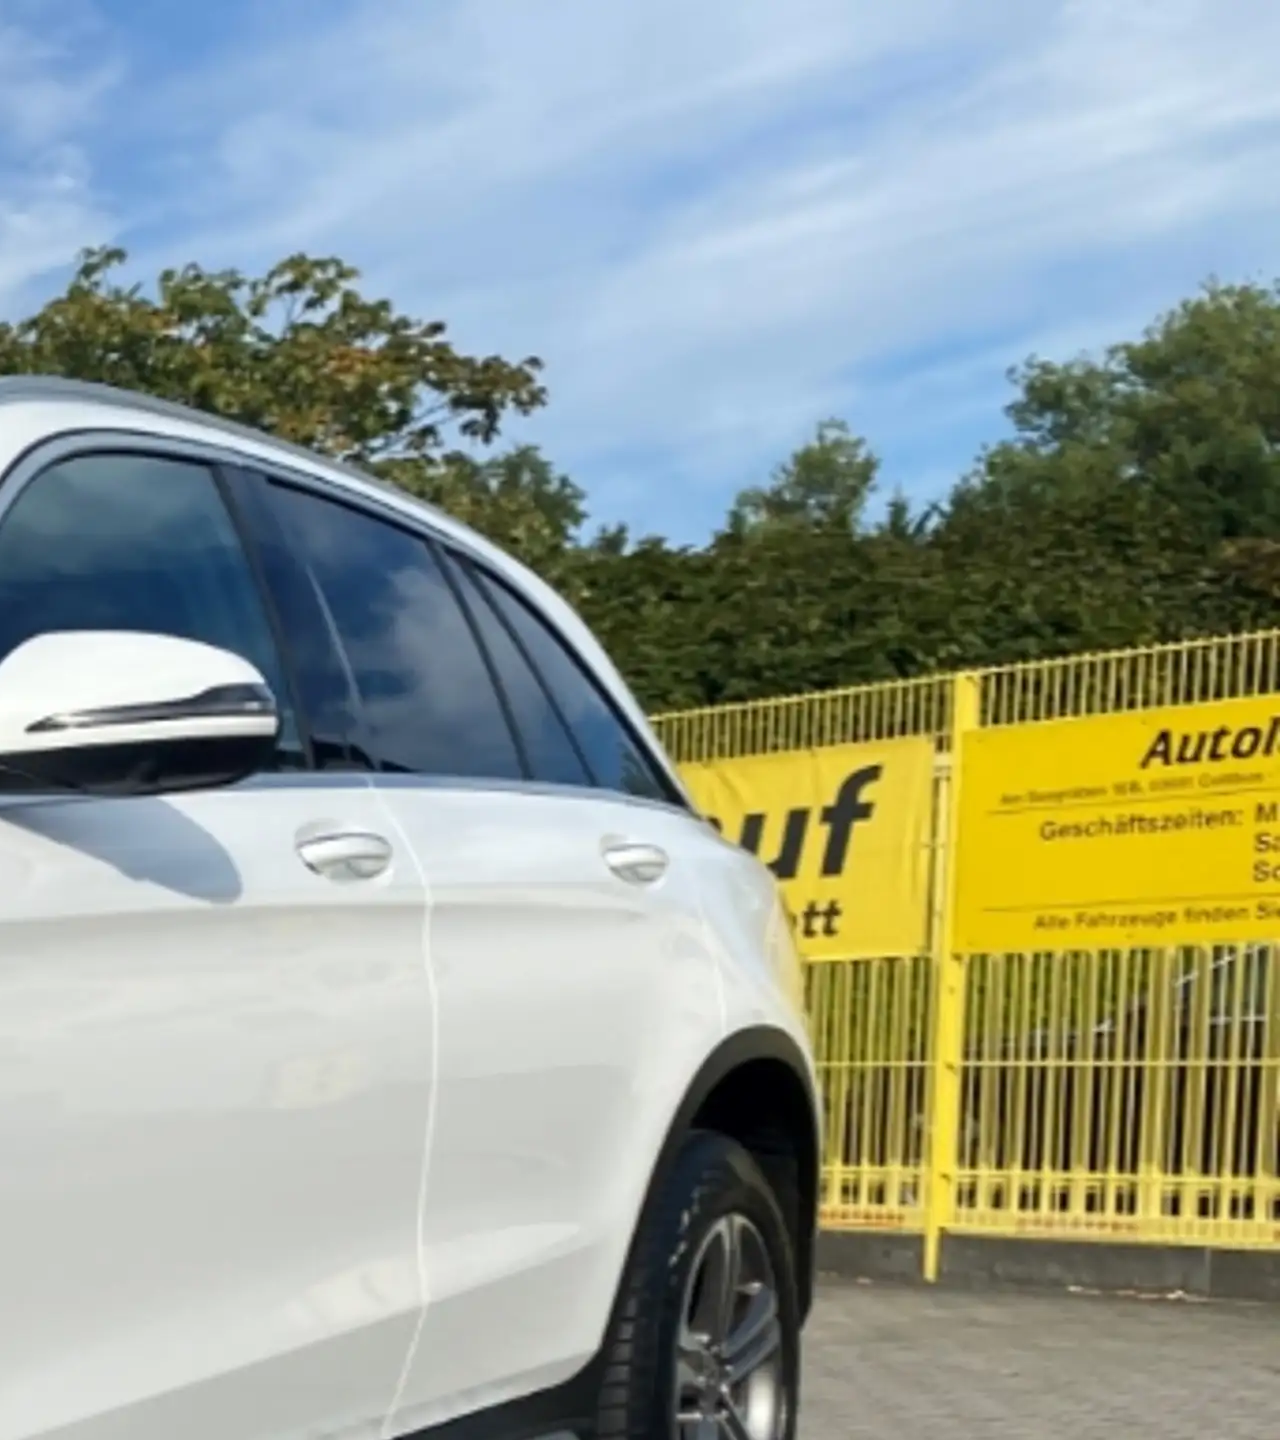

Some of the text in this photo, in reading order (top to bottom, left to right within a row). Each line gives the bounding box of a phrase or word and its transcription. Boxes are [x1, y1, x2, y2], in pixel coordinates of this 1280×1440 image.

[1139, 715, 1280, 769] Autol
[707, 763, 884, 880] uf
[1040, 808, 1244, 841] Geschäftszeiten:
[790, 900, 843, 938] tt
